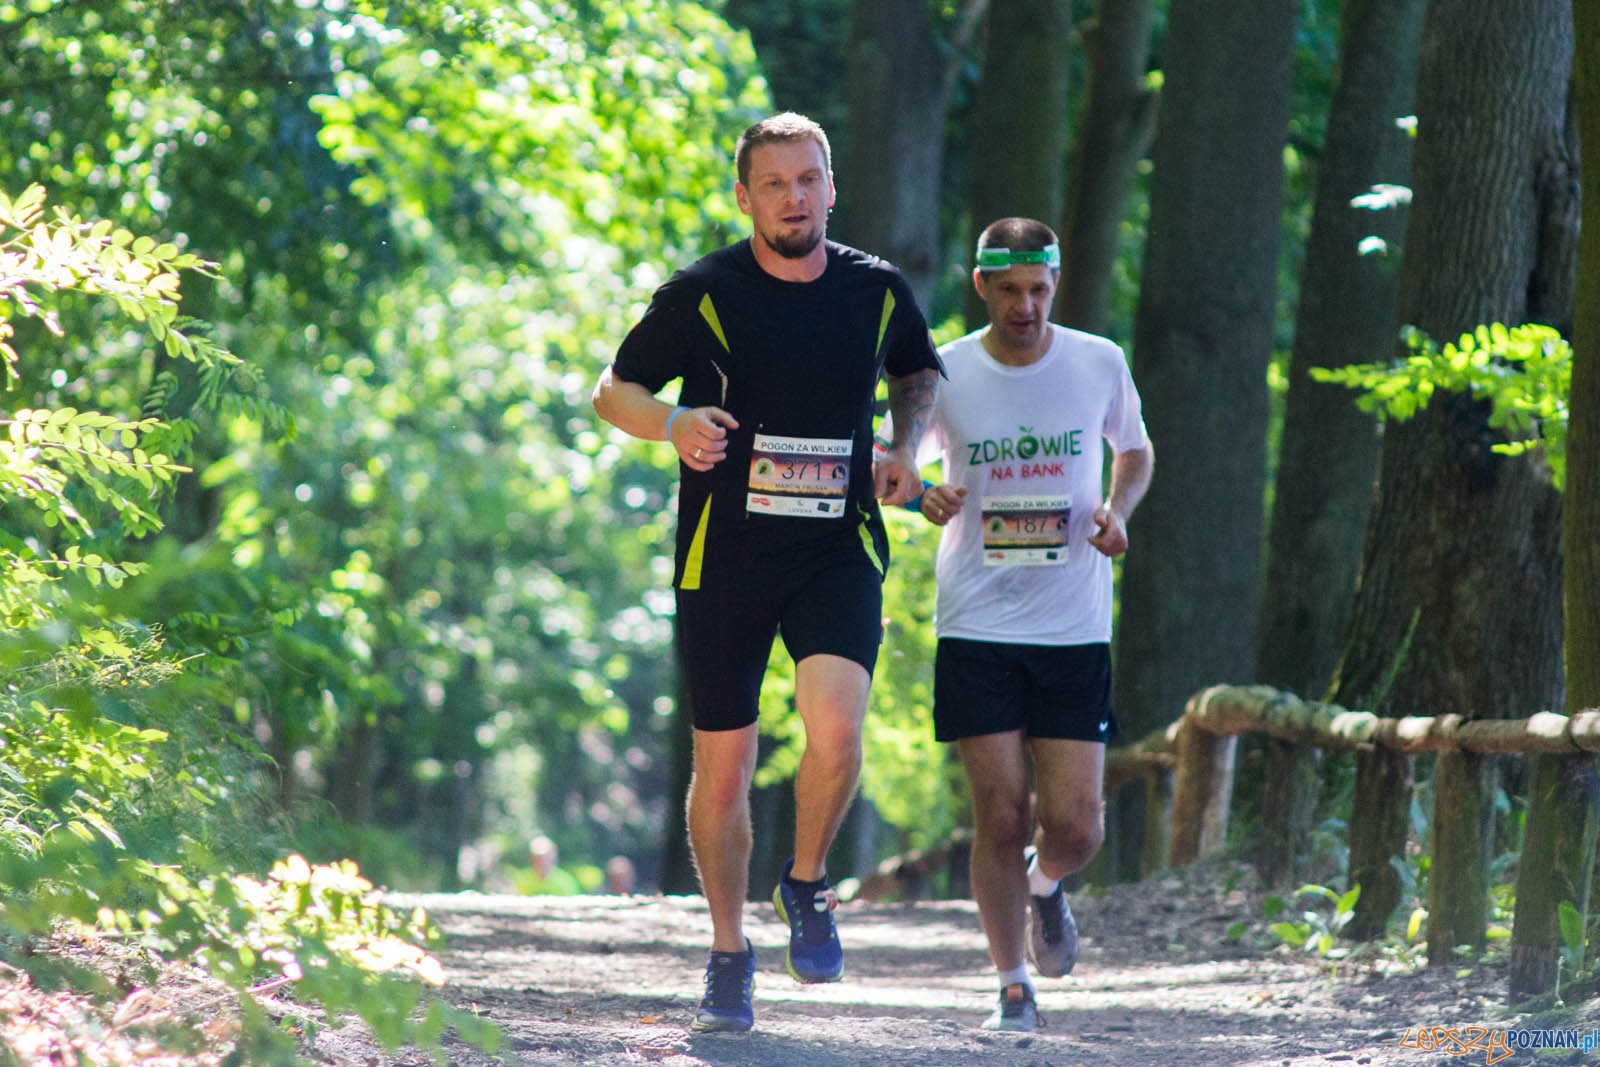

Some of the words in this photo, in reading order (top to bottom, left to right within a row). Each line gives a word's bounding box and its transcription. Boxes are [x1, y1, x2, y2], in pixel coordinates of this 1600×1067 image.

[796, 444, 809, 452] ZA
[810, 445, 848, 454] WILKIEM
[967, 429, 1083, 466] ZDROWIE
[782, 460, 821, 480] 371
[991, 466, 1014, 480] NA
[1021, 463, 1064, 478] BANK
[1015, 516, 1048, 533] 187
